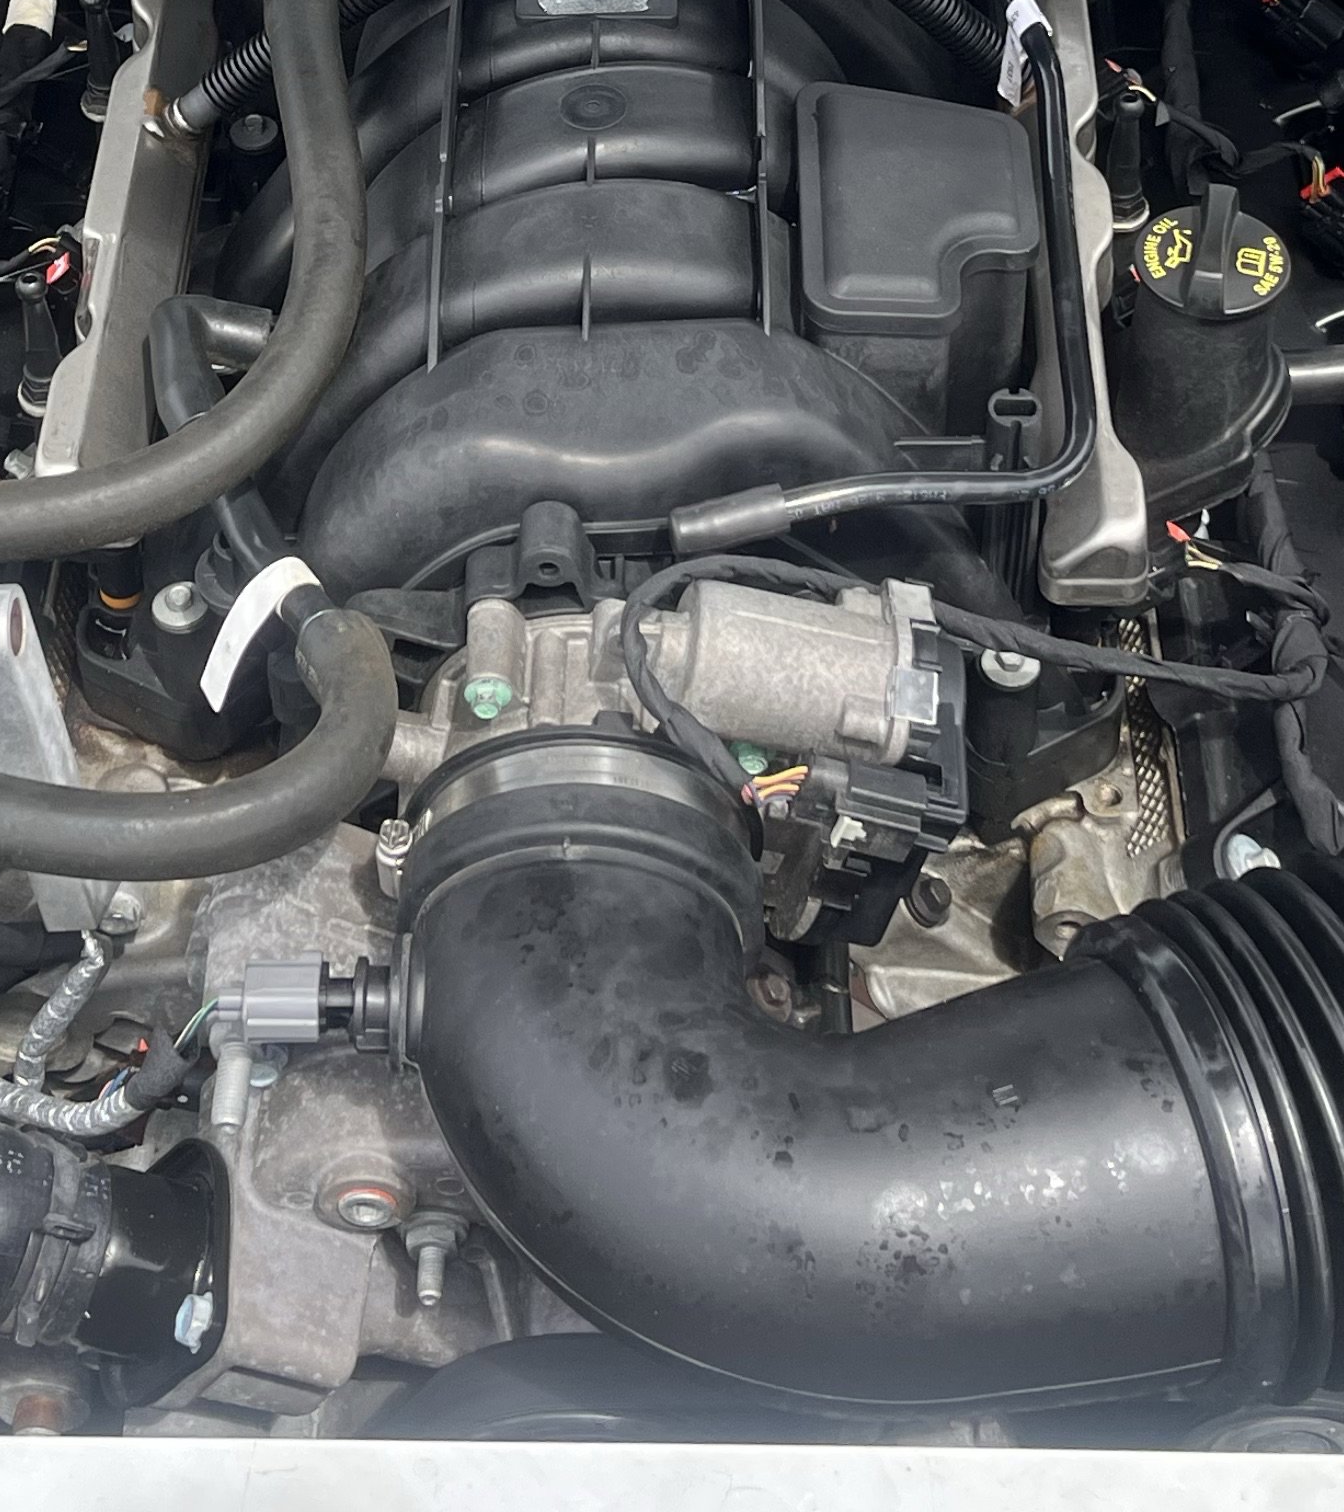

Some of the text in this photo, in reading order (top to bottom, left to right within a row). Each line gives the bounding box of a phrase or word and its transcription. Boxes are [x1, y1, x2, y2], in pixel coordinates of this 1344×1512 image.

[1142, 216, 1179, 280] ENGINE OIL
[1252, 235, 1285, 297] SAE 5W-20
